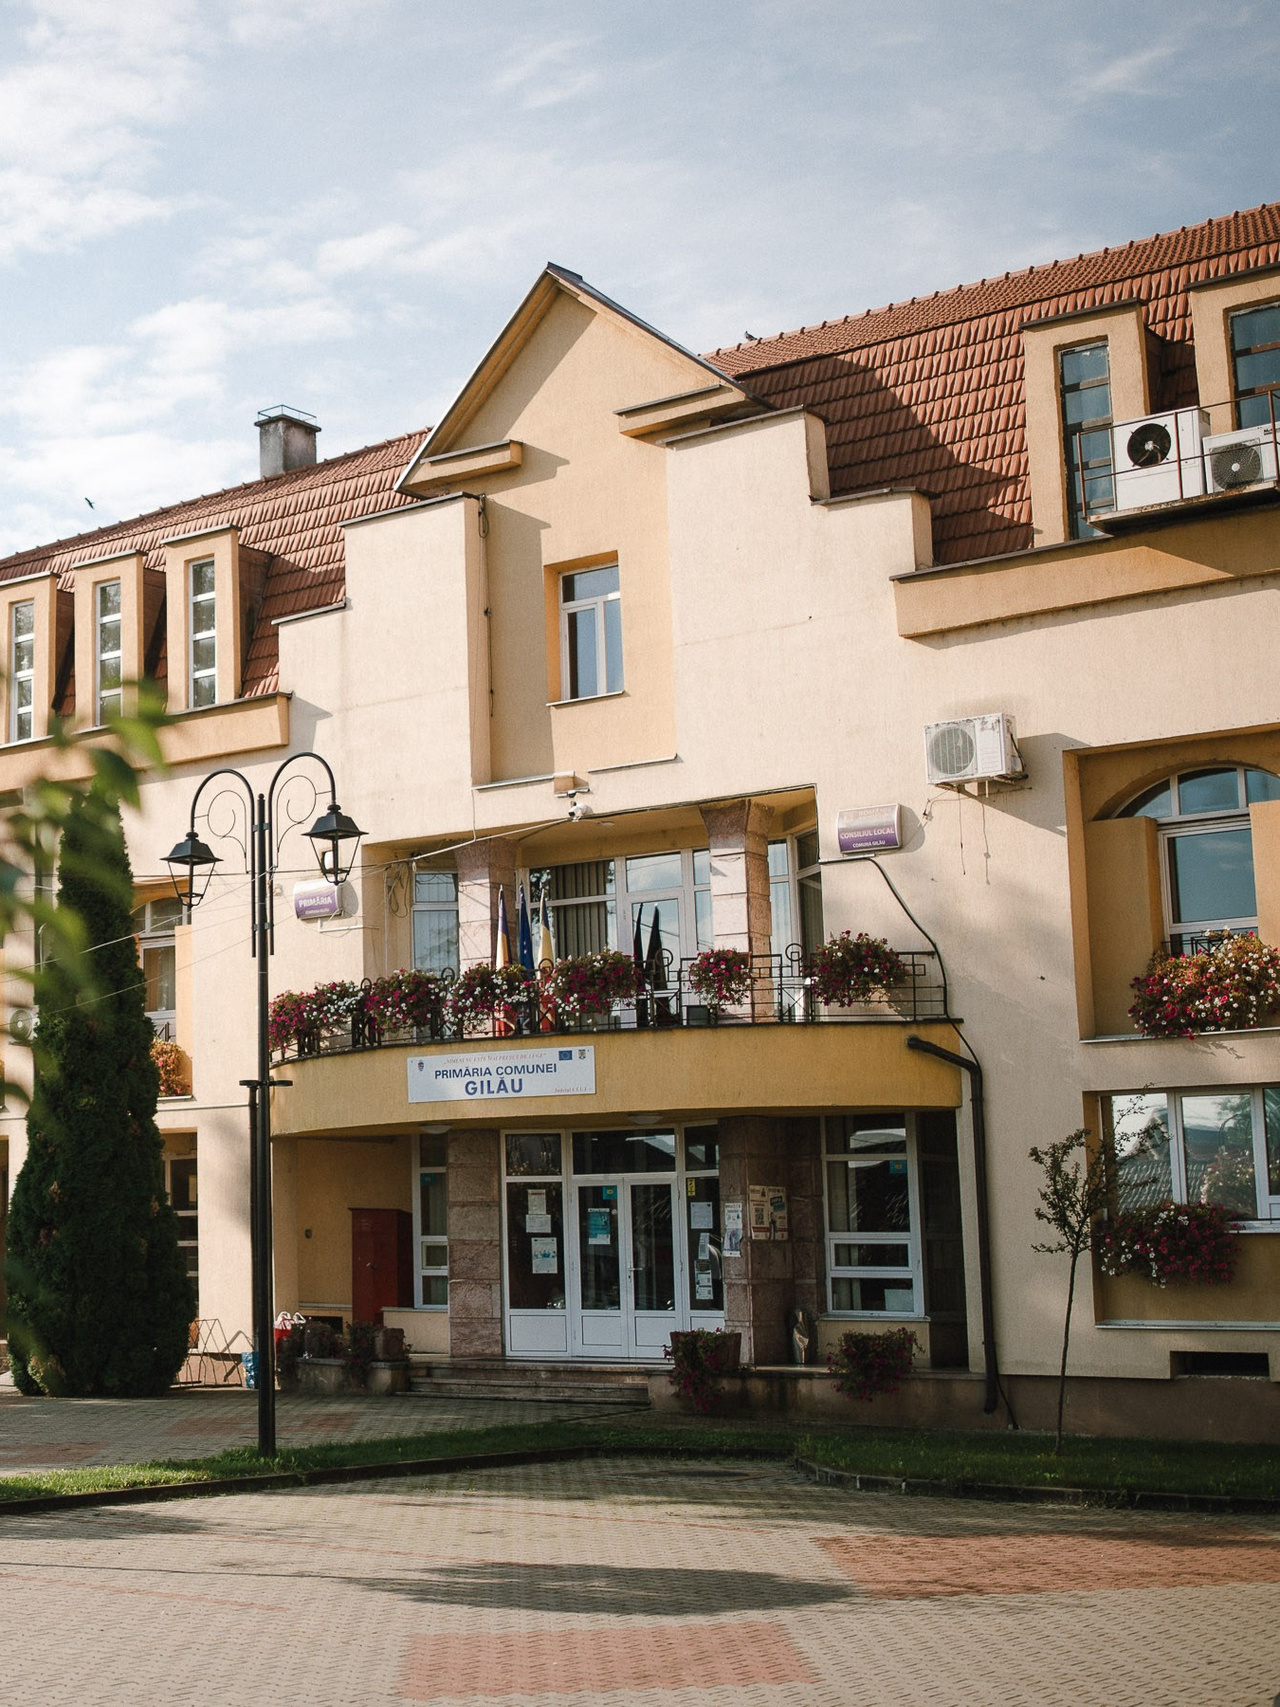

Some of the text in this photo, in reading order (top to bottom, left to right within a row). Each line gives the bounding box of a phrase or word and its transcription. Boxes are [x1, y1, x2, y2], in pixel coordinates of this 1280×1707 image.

[840, 828, 894, 839] CONSILIUL LOCAL
[299, 896, 332, 907] PRIMĂRIA
[434, 1063, 557, 1079] PRIMĂRIA COMUNEI
[465, 1077, 524, 1095] GILĂU
